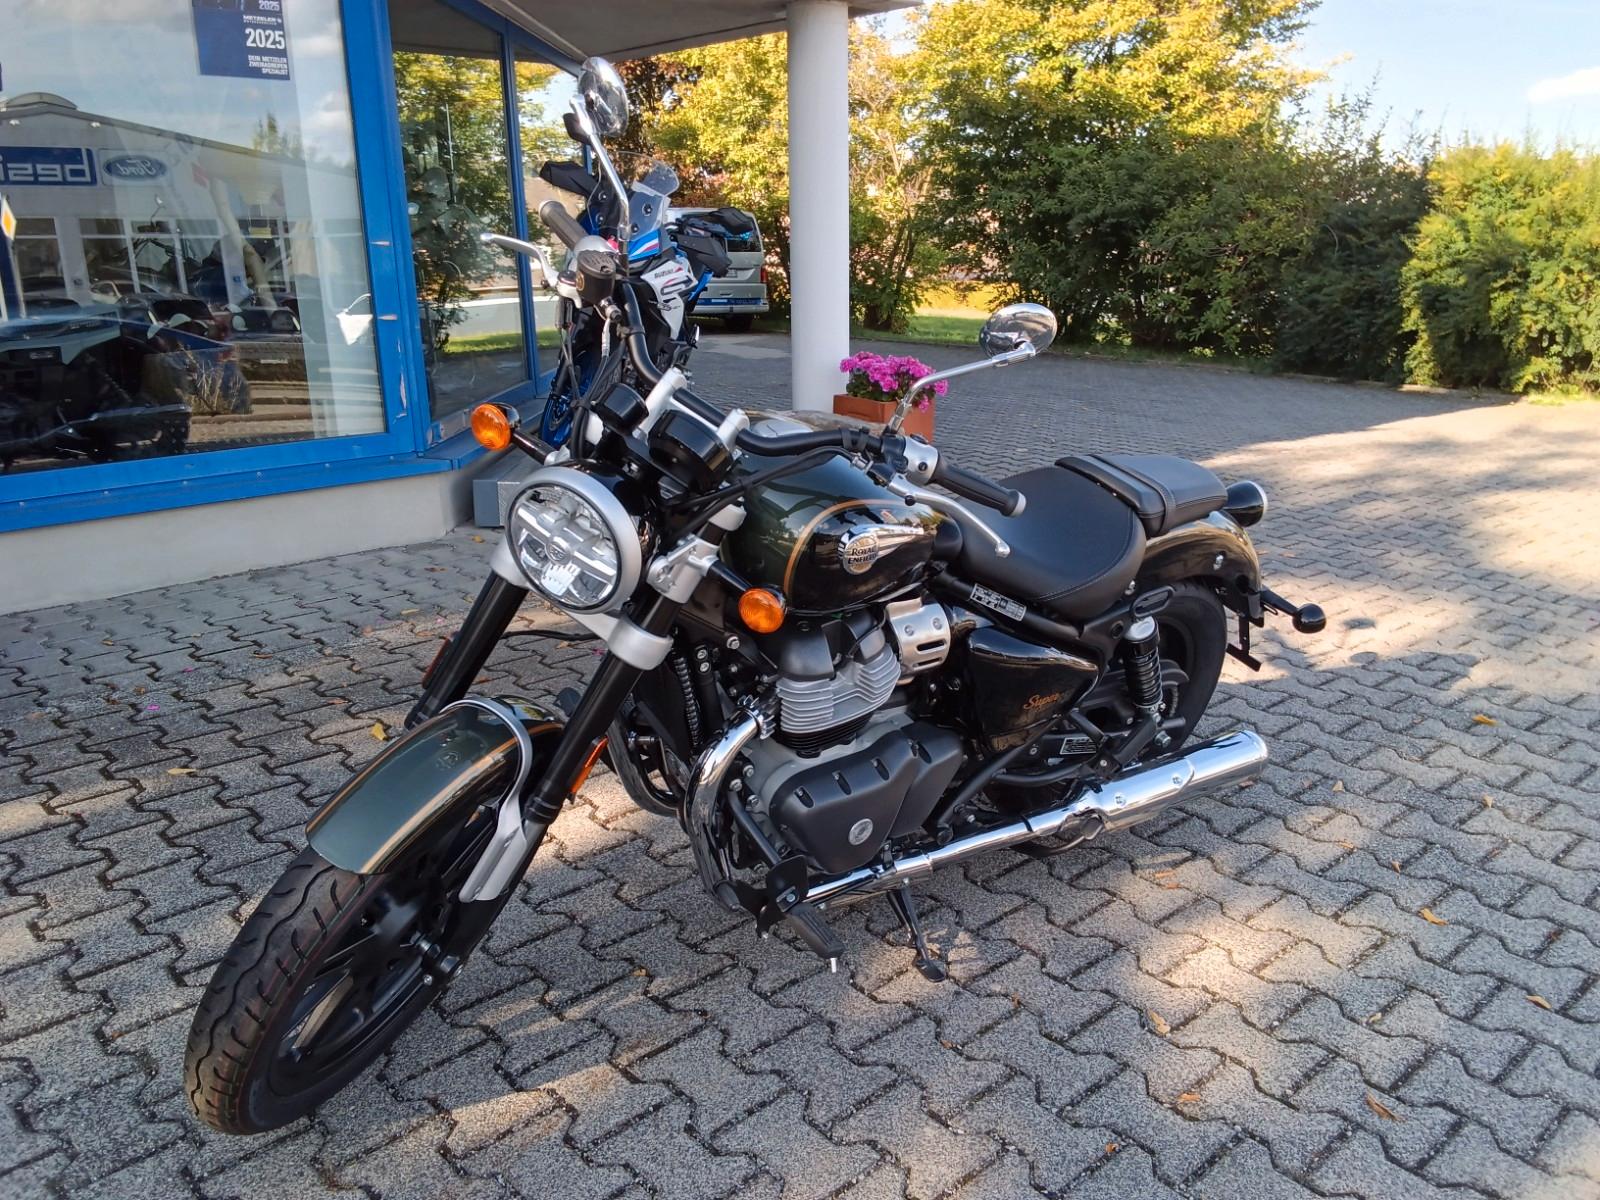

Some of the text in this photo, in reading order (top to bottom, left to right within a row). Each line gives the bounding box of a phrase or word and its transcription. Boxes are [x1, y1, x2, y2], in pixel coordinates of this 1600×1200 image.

[245, 28, 285, 49] 2025
[851, 546, 875, 556] ROYAL
[848, 554, 877, 565] ENFIELD
